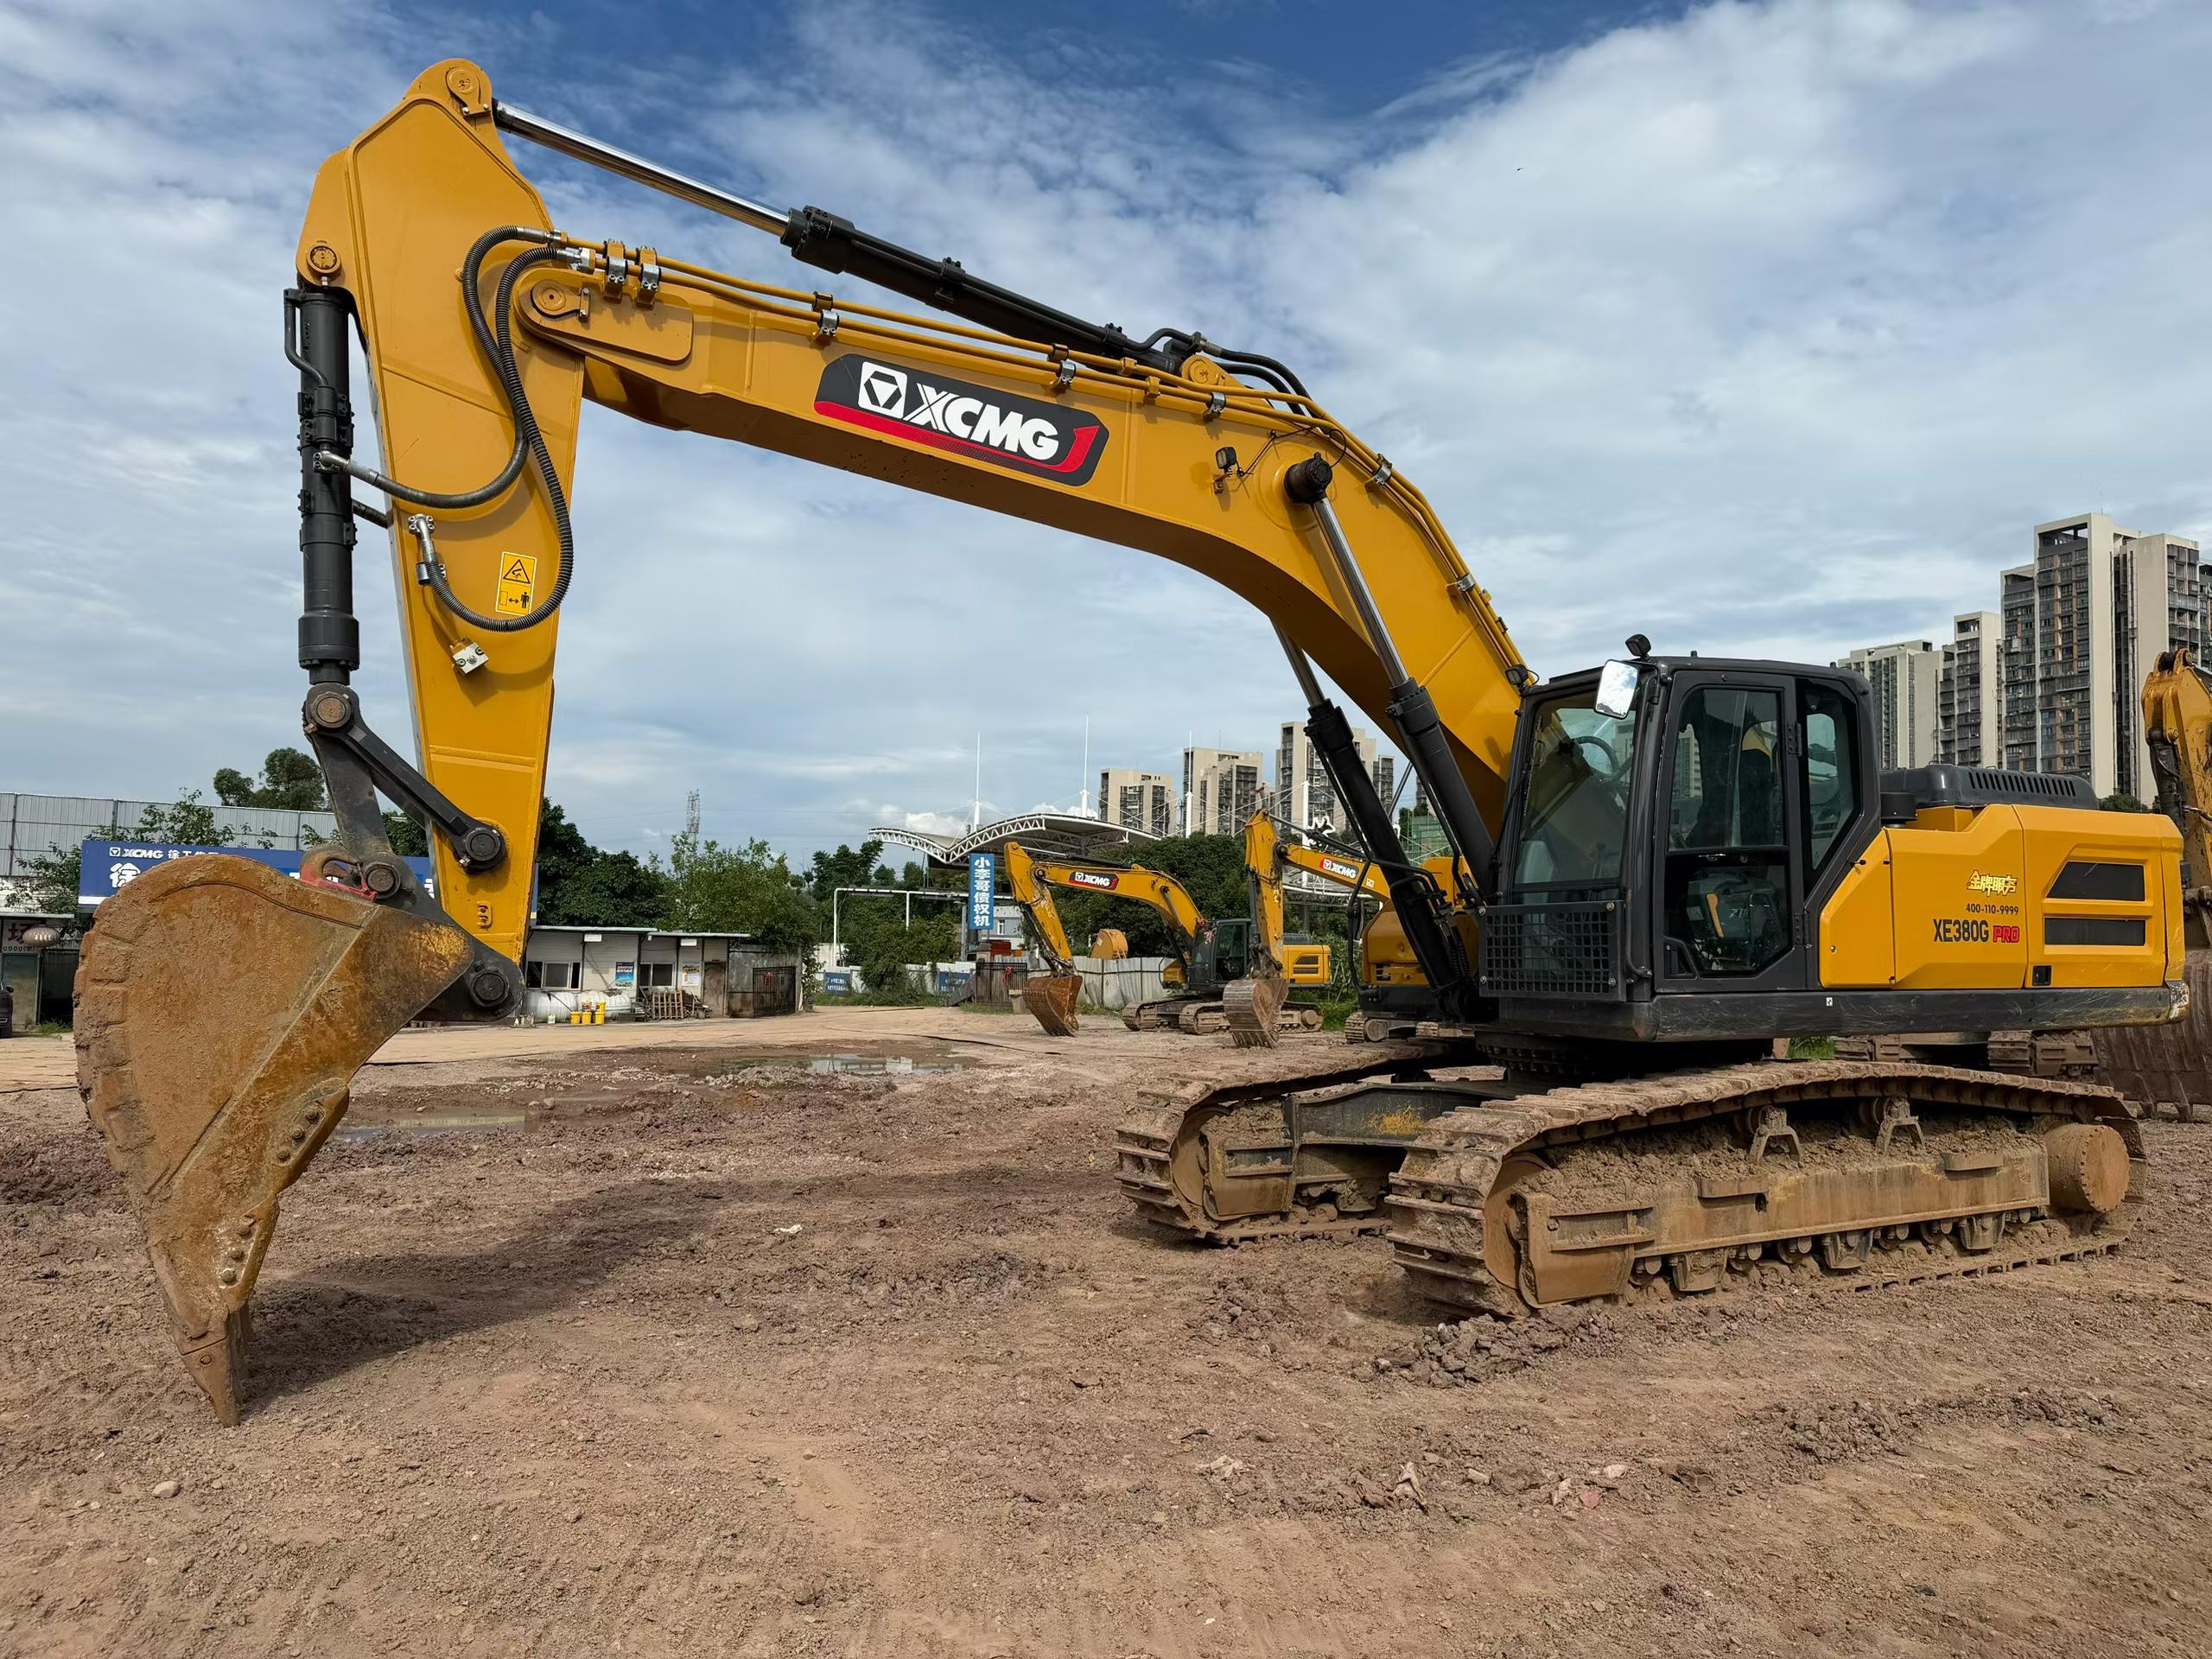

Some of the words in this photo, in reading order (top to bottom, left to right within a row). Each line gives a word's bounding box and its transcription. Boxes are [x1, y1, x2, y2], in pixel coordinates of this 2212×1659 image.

[903, 383, 1059, 461] XCMG
[122, 849, 164, 859] XCMG
[1331, 862, 1357, 879] XCMG
[1083, 874, 1110, 887] XCMG
[1966, 869, 2018, 897] 金牌服务
[1966, 903, 2019, 915] 400-110-9999
[1933, 918, 1990, 943] XE380G
[1992, 925, 2020, 943] PRO
